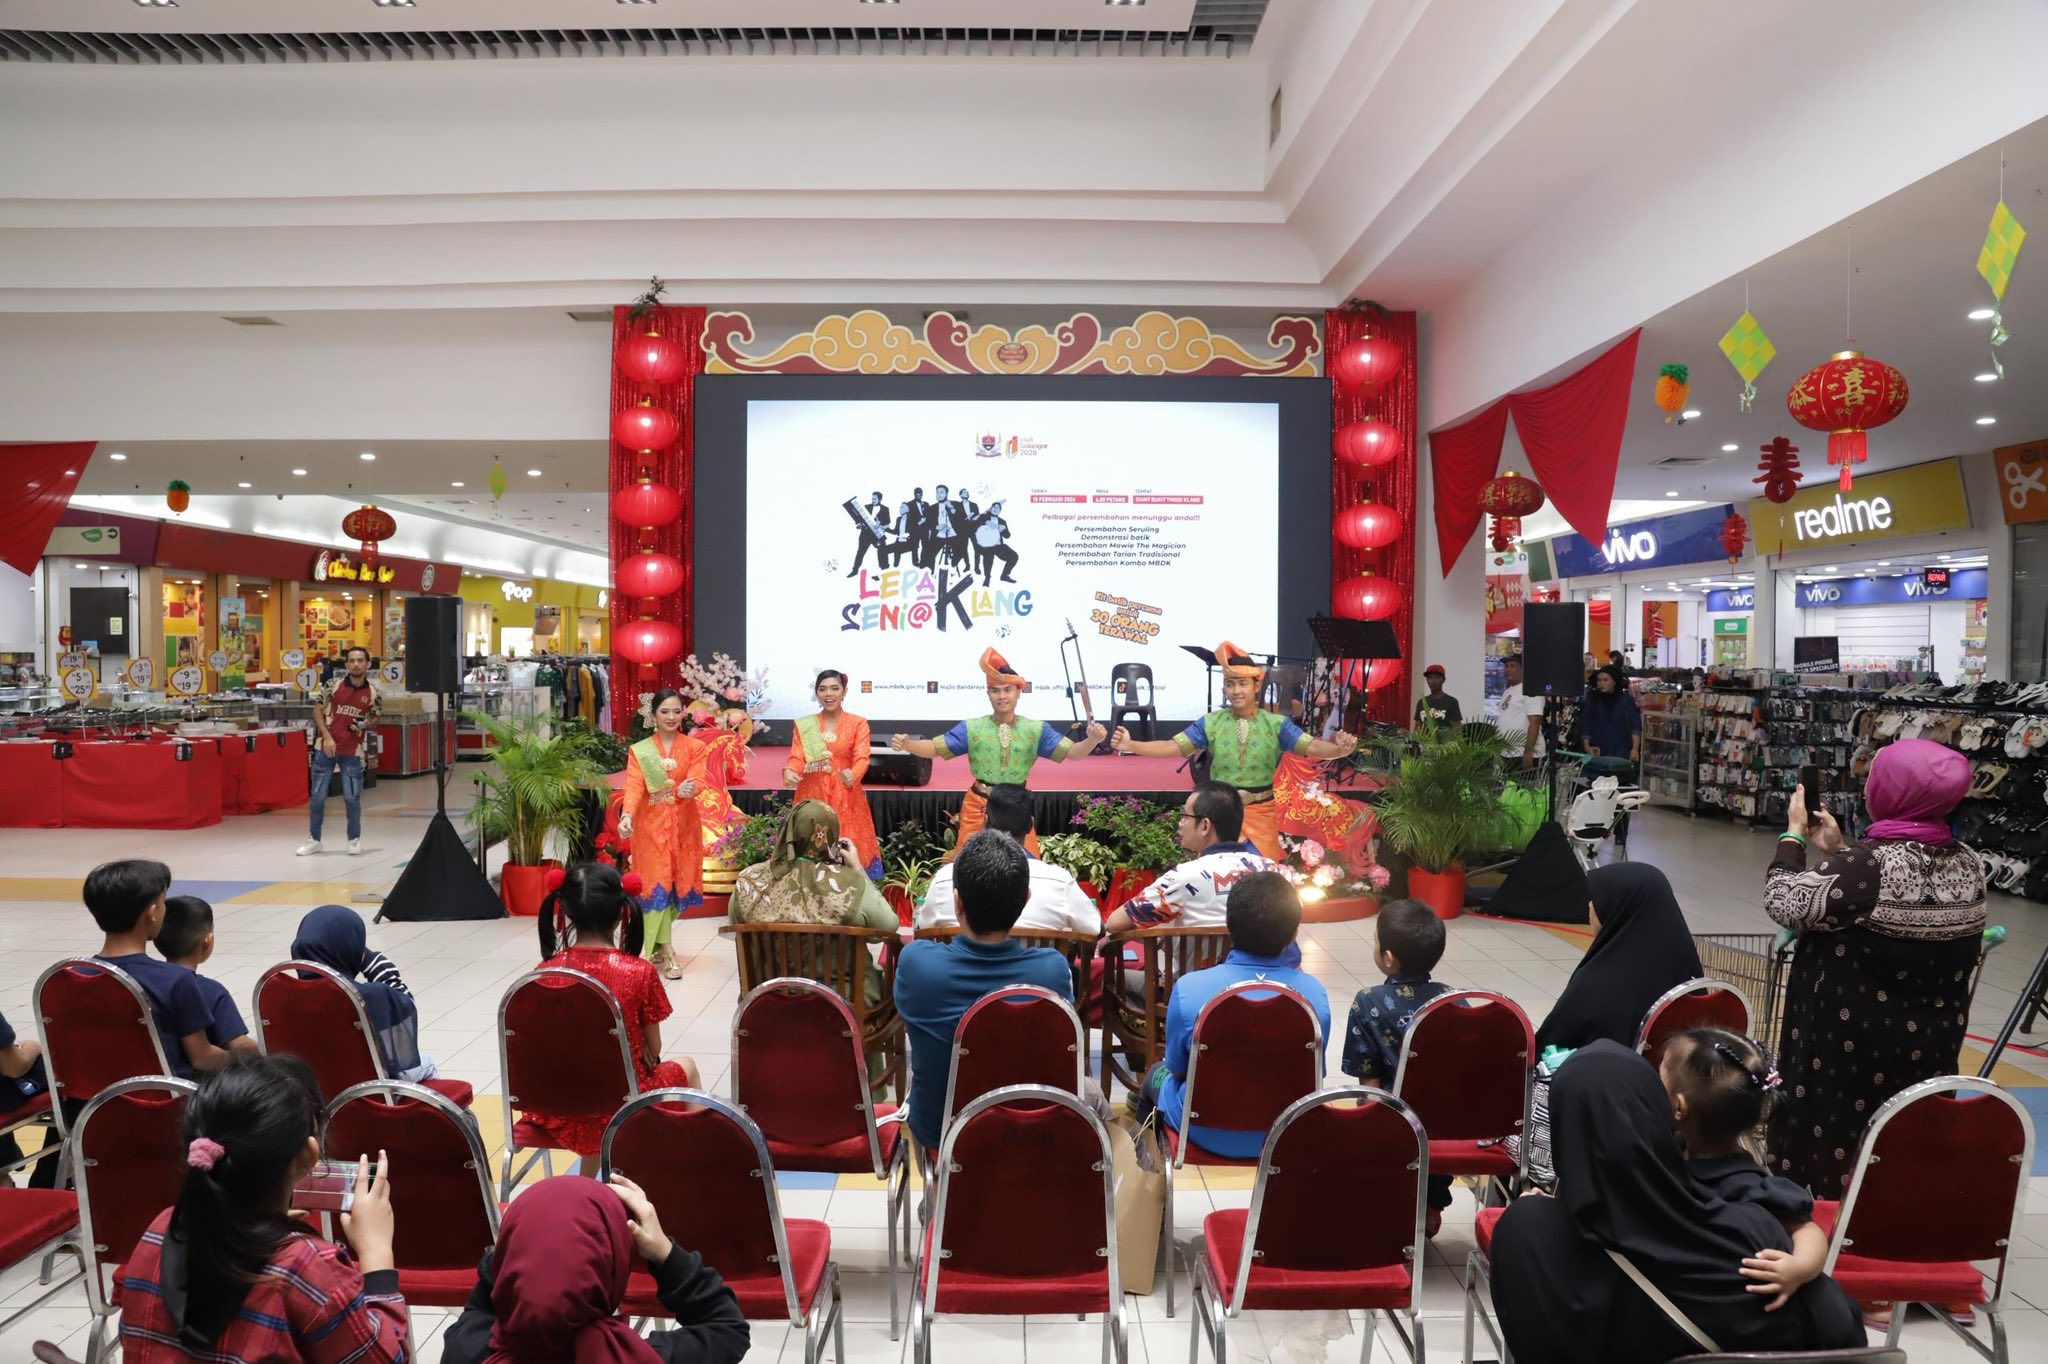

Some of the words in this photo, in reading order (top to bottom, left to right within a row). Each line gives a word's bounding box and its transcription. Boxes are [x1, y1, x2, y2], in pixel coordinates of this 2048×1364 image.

[1077, 514, 1130, 522] persembahan
[1131, 514, 1173, 523] menunggu
[1794, 493, 1892, 541] realme
[1128, 526, 1160, 534] Seruling
[1151, 542, 1187, 550] Magician
[1601, 528, 1656, 564] vivo
[1138, 550, 1181, 558] Tradisional
[1065, 559, 1119, 567] Persembahan
[1120, 559, 1147, 567] Kombo
[1927, 573, 1947, 582] REPAIR
[1805, 583, 1841, 602] vivo
[1725, 590, 1754, 607] vivo
[1090, 608, 1110, 624] 30
[1110, 614, 1161, 637] ORANG
[1098, 624, 1149, 646] TERAWAL
[1809, 663, 1839, 673] SPECIALIST
